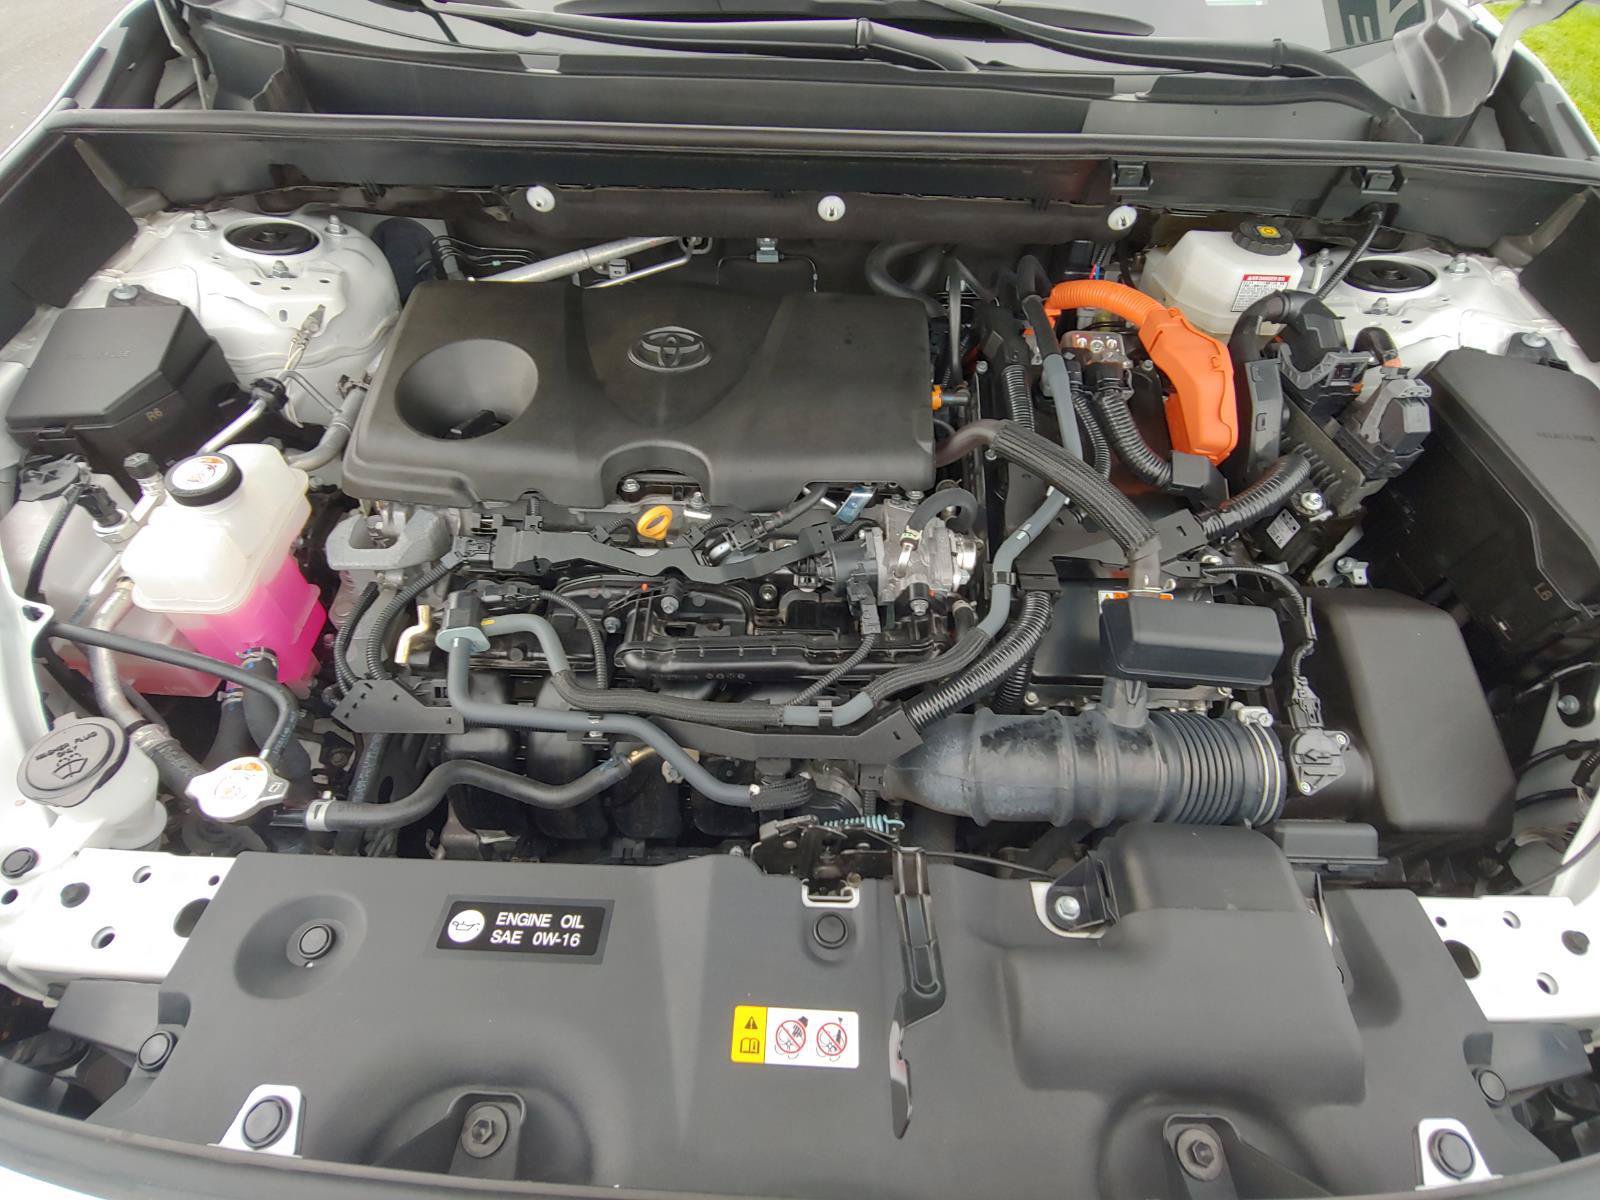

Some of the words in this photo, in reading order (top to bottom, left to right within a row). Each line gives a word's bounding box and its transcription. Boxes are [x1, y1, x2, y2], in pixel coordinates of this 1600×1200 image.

[145, 407, 163, 422] R6
[495, 911, 553, 928] ENGINE
[560, 914, 585, 929] OIL
[490, 929, 524, 945] SAE
[532, 931, 581, 947] 0W-16
